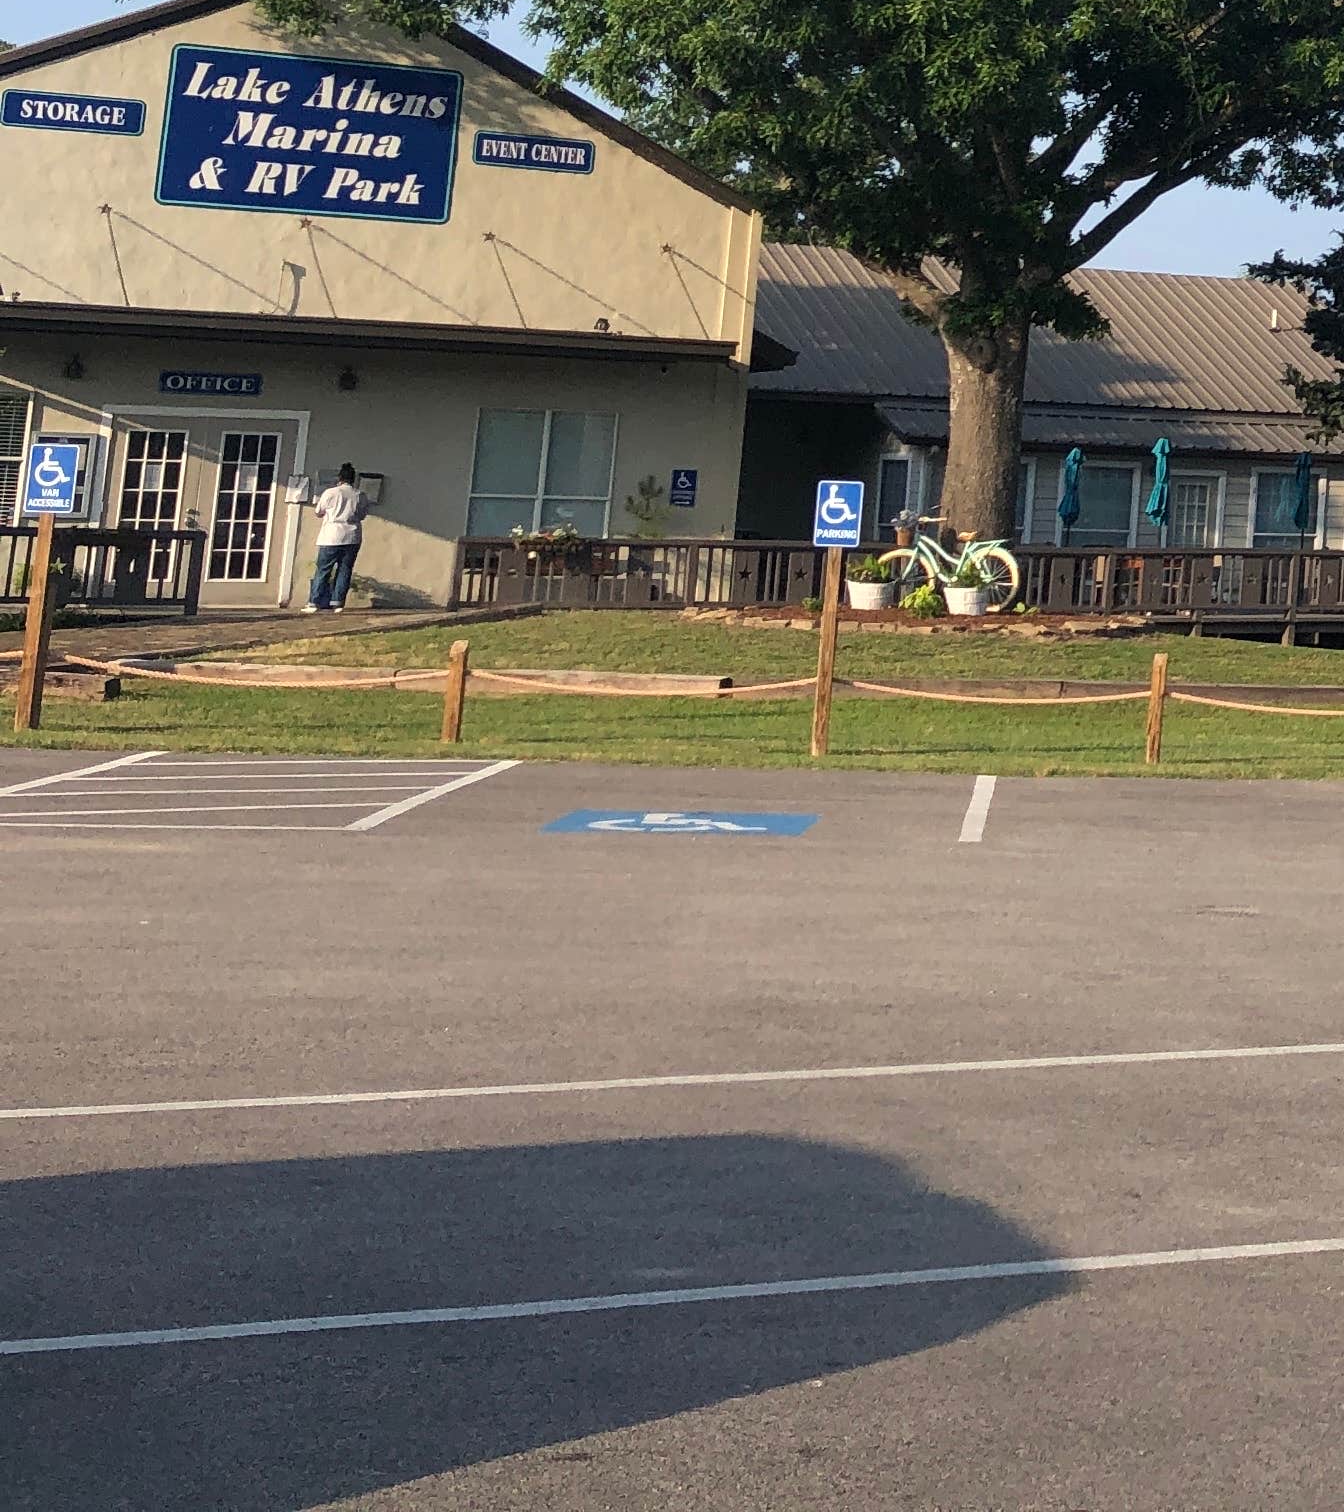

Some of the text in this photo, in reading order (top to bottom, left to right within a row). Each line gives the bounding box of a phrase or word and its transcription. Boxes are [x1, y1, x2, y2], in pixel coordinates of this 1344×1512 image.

[183, 62, 449, 119] Lake Athens
[20, 99, 126, 126] STORAGE
[222, 110, 402, 158] Marina
[481, 139, 586, 165] EVENT CENTER
[188, 157, 425, 205] & RV Park
[166, 375, 256, 392] OFFICE
[28, 498, 71, 508] ACCESSIBLE
[41, 488, 60, 498] VAN
[816, 529, 857, 539] PARKING
